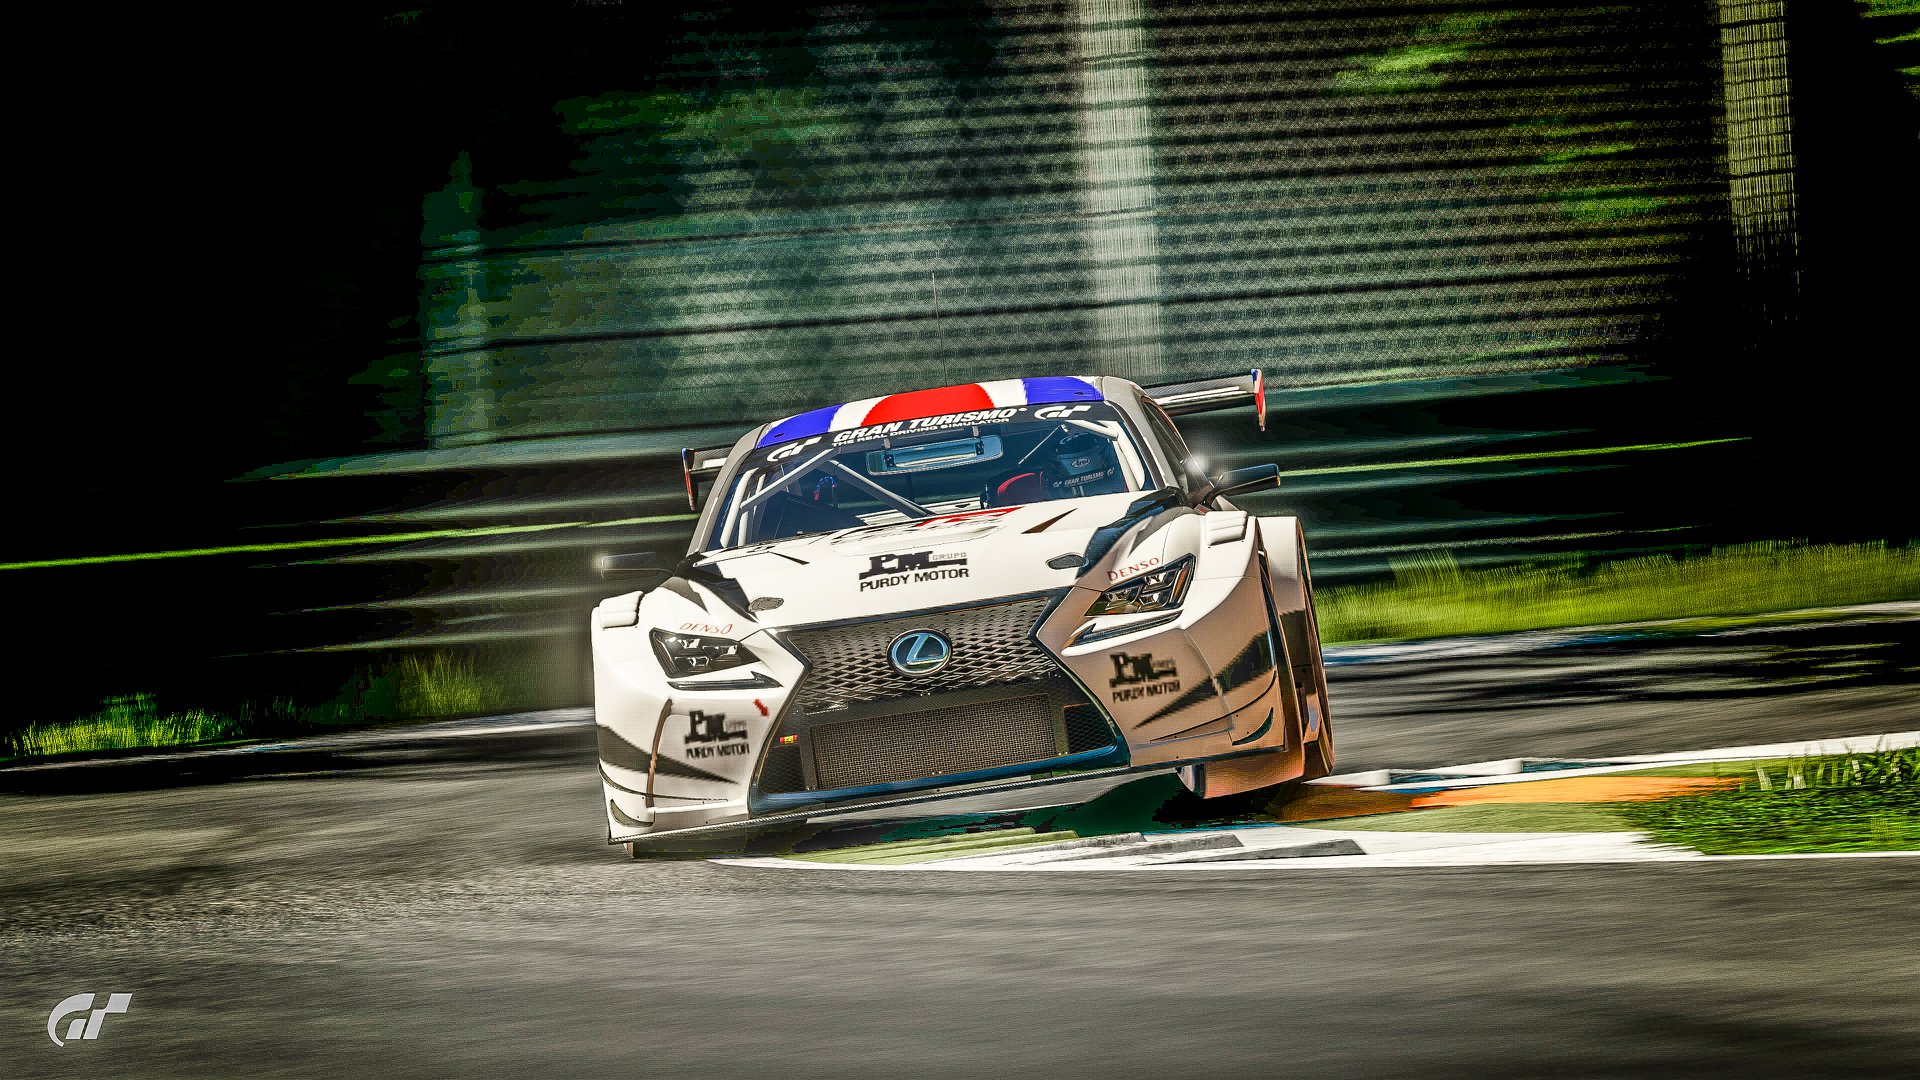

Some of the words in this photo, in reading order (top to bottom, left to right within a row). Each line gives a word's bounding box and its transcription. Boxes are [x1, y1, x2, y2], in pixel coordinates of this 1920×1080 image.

[831, 439, 855, 447] THE
[857, 433, 888, 443] REAL
[890, 426, 938, 436] DRIVING
[941, 418, 1010, 429] SIMULATOR
[833, 421, 903, 443] GRAN
[909, 407, 1019, 428] TURISMO
[932, 552, 967, 561] GRUPO
[859, 574, 910, 592] PURDY
[914, 568, 970, 584] MOTOR
[1107, 557, 1160, 582] DENSO
[679, 622, 734, 635] DENSO
